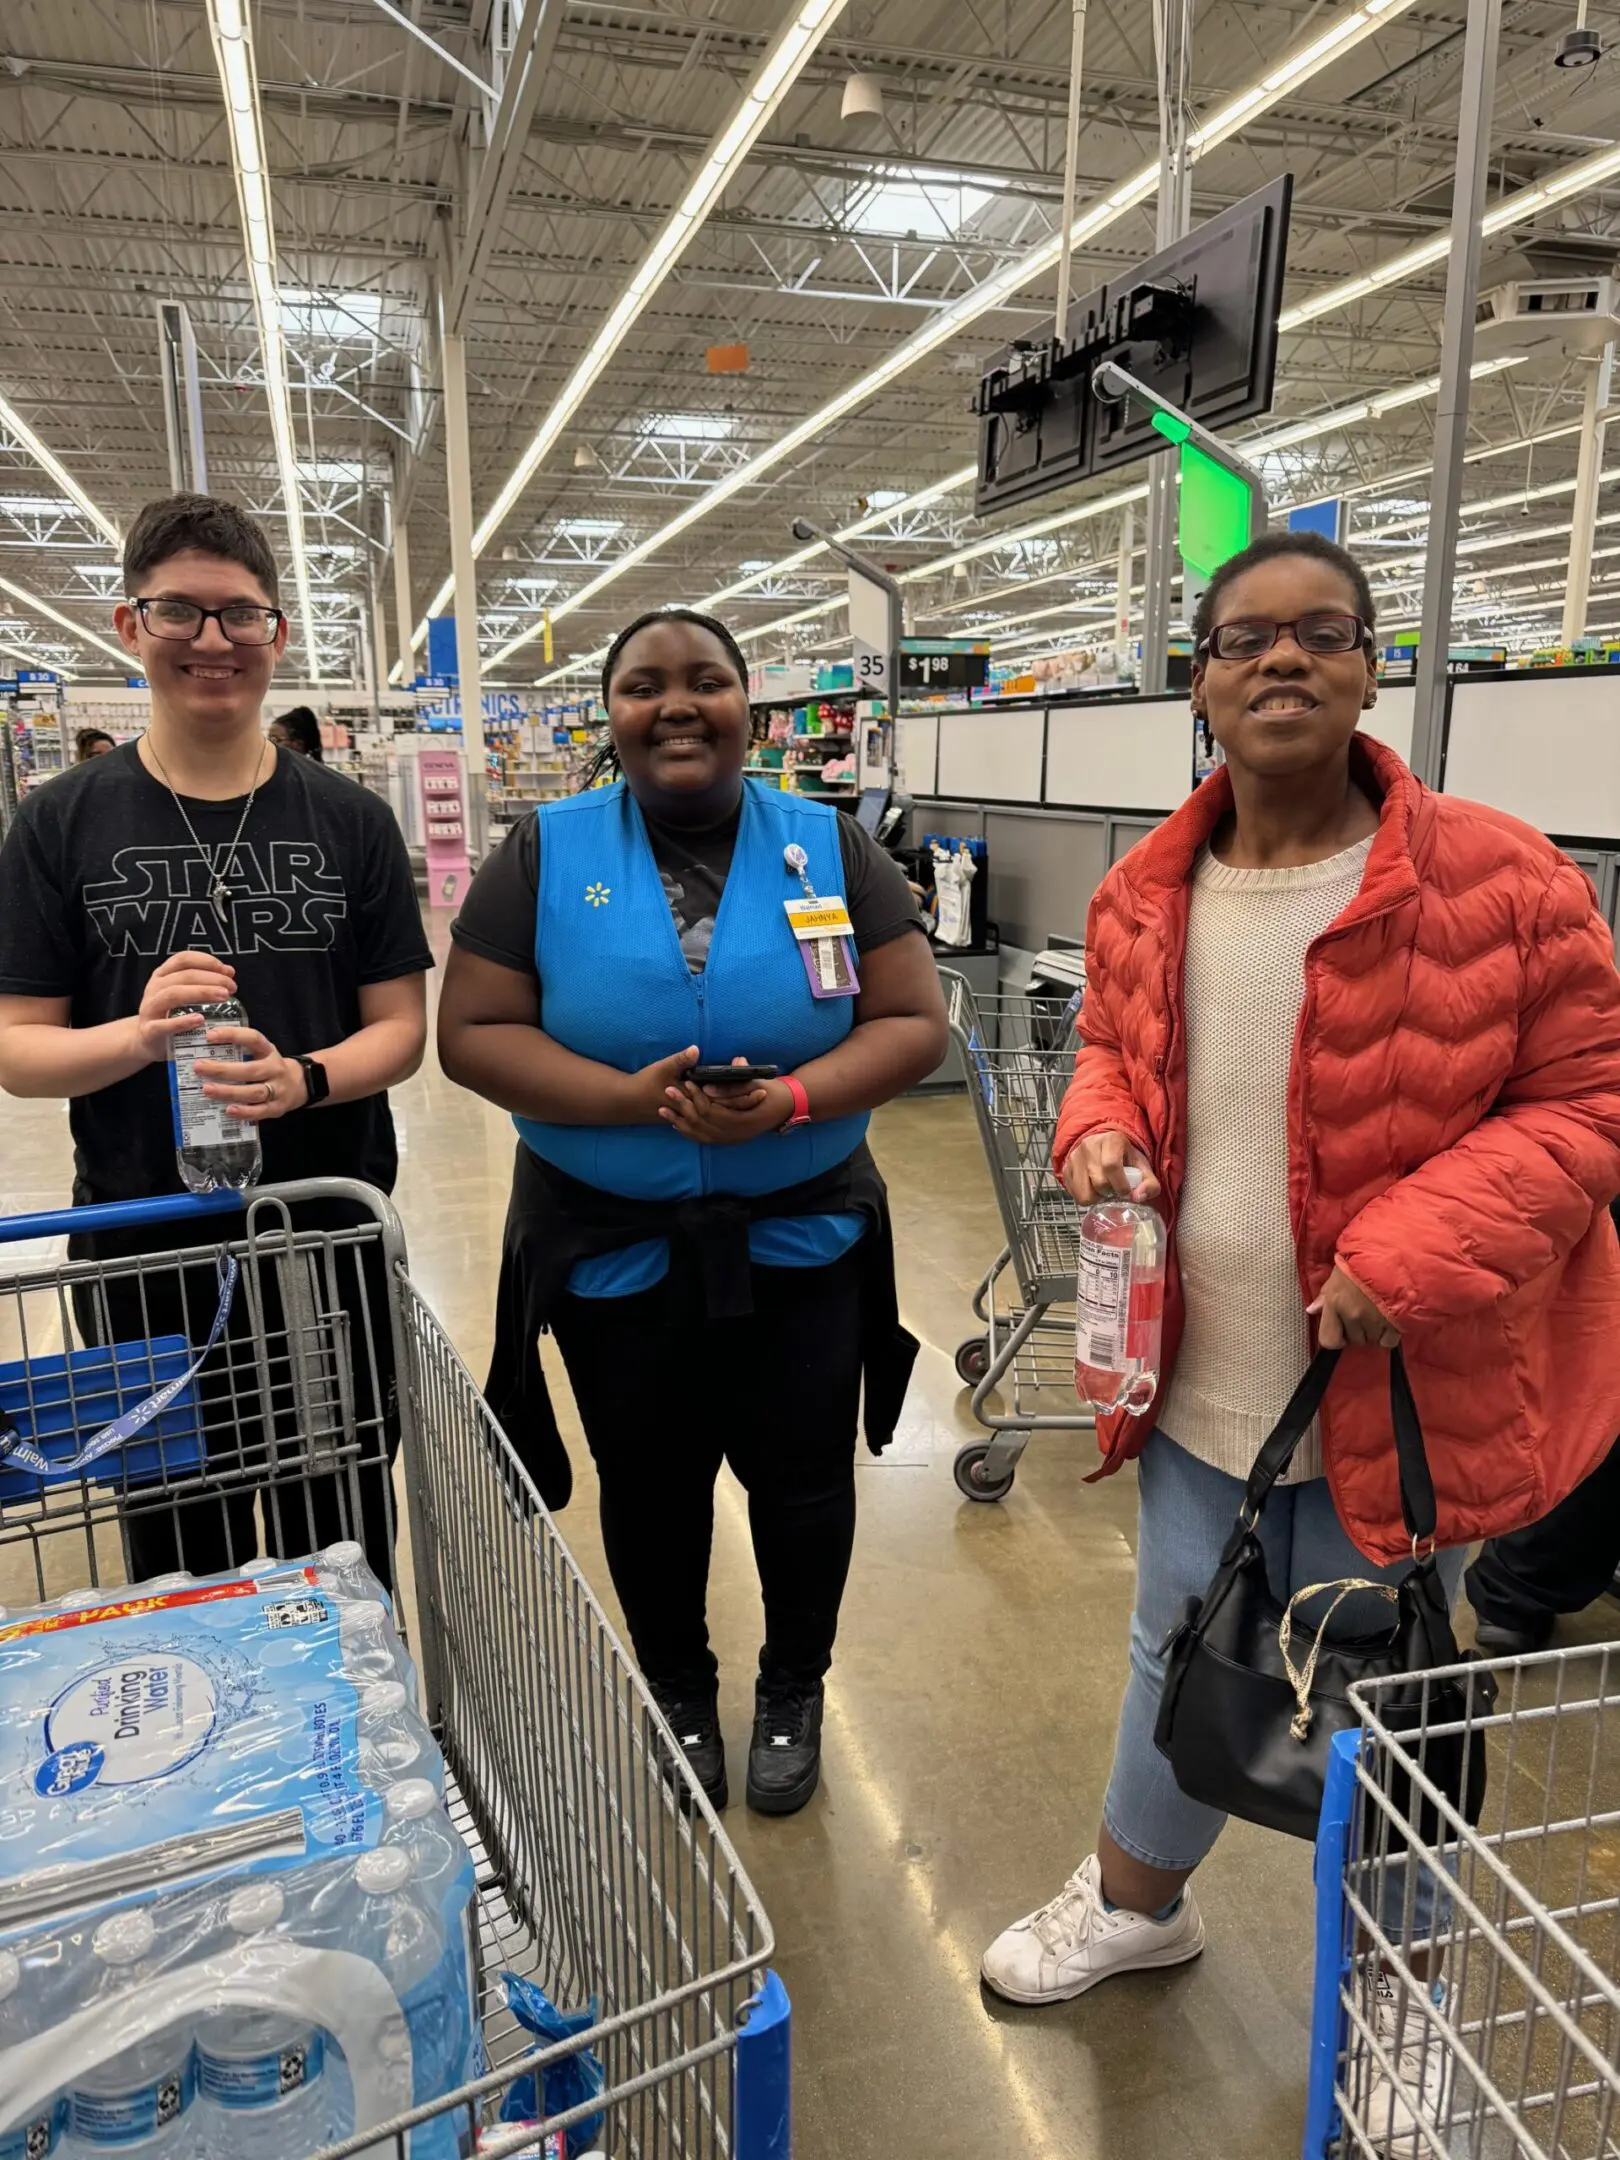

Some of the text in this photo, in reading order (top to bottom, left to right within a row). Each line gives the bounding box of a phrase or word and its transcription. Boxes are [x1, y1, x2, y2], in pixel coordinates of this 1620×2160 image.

[860, 655, 884, 676] 35
[83, 841, 346, 905] STAR
[86, 897, 347, 958] WARS
[113, 1669, 148, 1741] Drinking
[142, 1666, 169, 1716] Water
